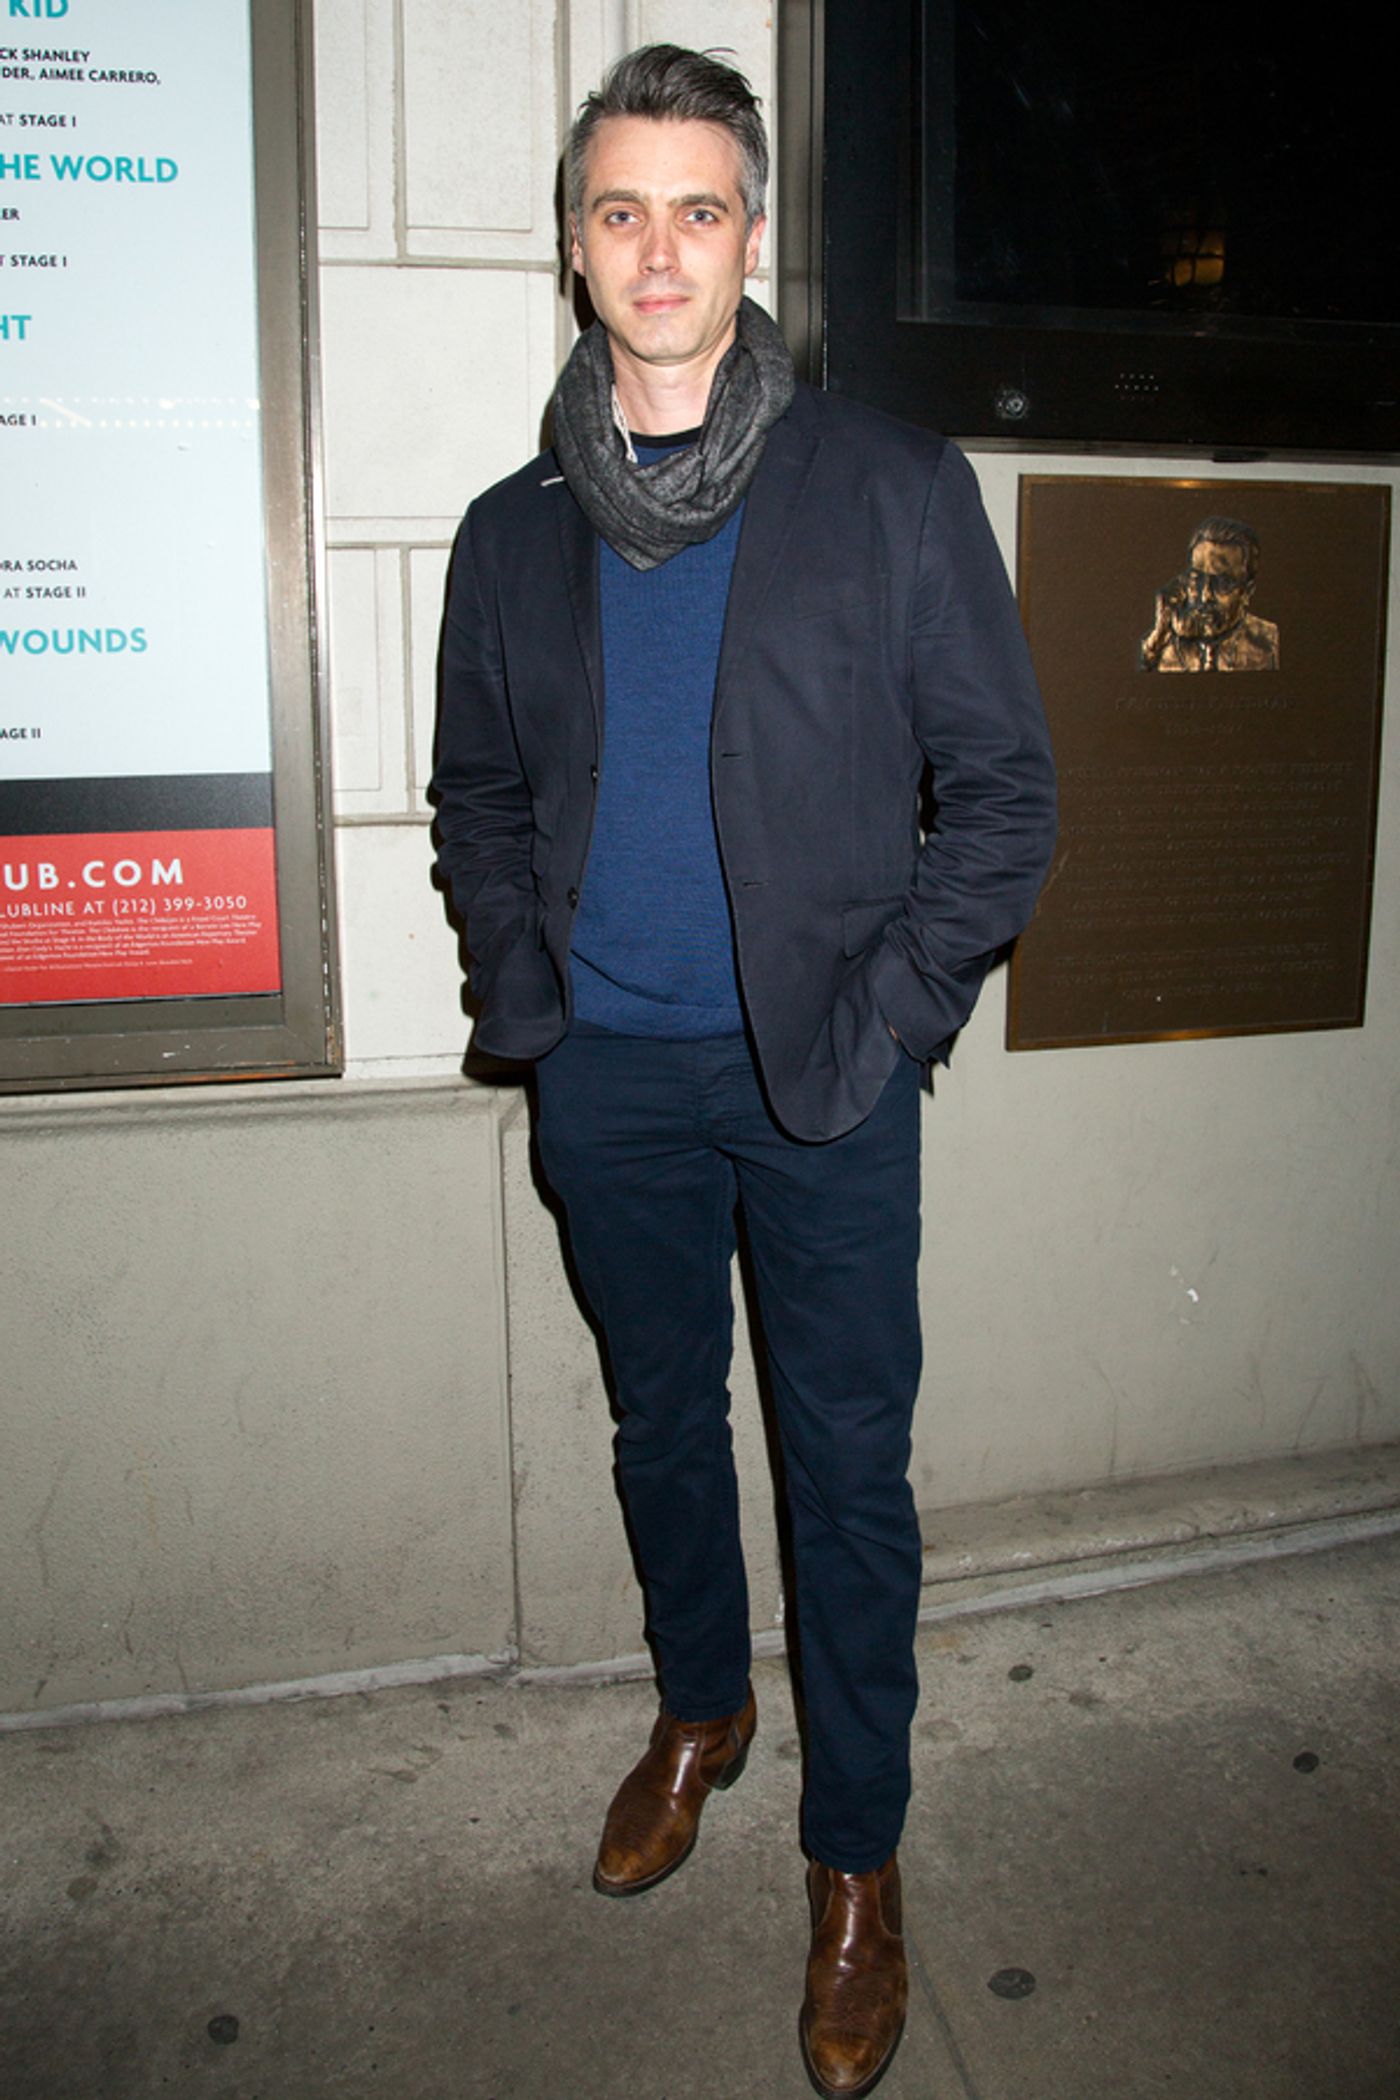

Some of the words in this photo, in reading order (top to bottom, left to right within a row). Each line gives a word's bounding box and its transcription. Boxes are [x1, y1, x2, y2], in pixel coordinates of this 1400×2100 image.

[9, 0, 69, 18] KID
[22, 49, 90, 63] SHANLEY
[2, 67, 35, 81] DER,
[39, 69, 84, 82] AIMEE
[89, 70, 161, 85] CARRERO,
[19, 114, 66, 127] STAGE
[72, 115, 76, 128] I
[0, 153, 41, 180] HE
[50, 155, 178, 183] WORLD
[0, 208, 20, 221] ER
[10, 255, 57, 268] STAGE
[62, 256, 67, 268] I
[27, 560, 77, 571] SOCHA
[4, 588, 20, 598] AT
[26, 587, 70, 598] STAGE
[77, 587, 86, 598] II
[0, 627, 147, 655] WOUNDS
[31, 728, 41, 739] II
[4, 858, 184, 891] UB.COM
[84, 899, 105, 914] AT
[112, 897, 156, 916] (212)
[163, 896, 248, 911] 399-3050
